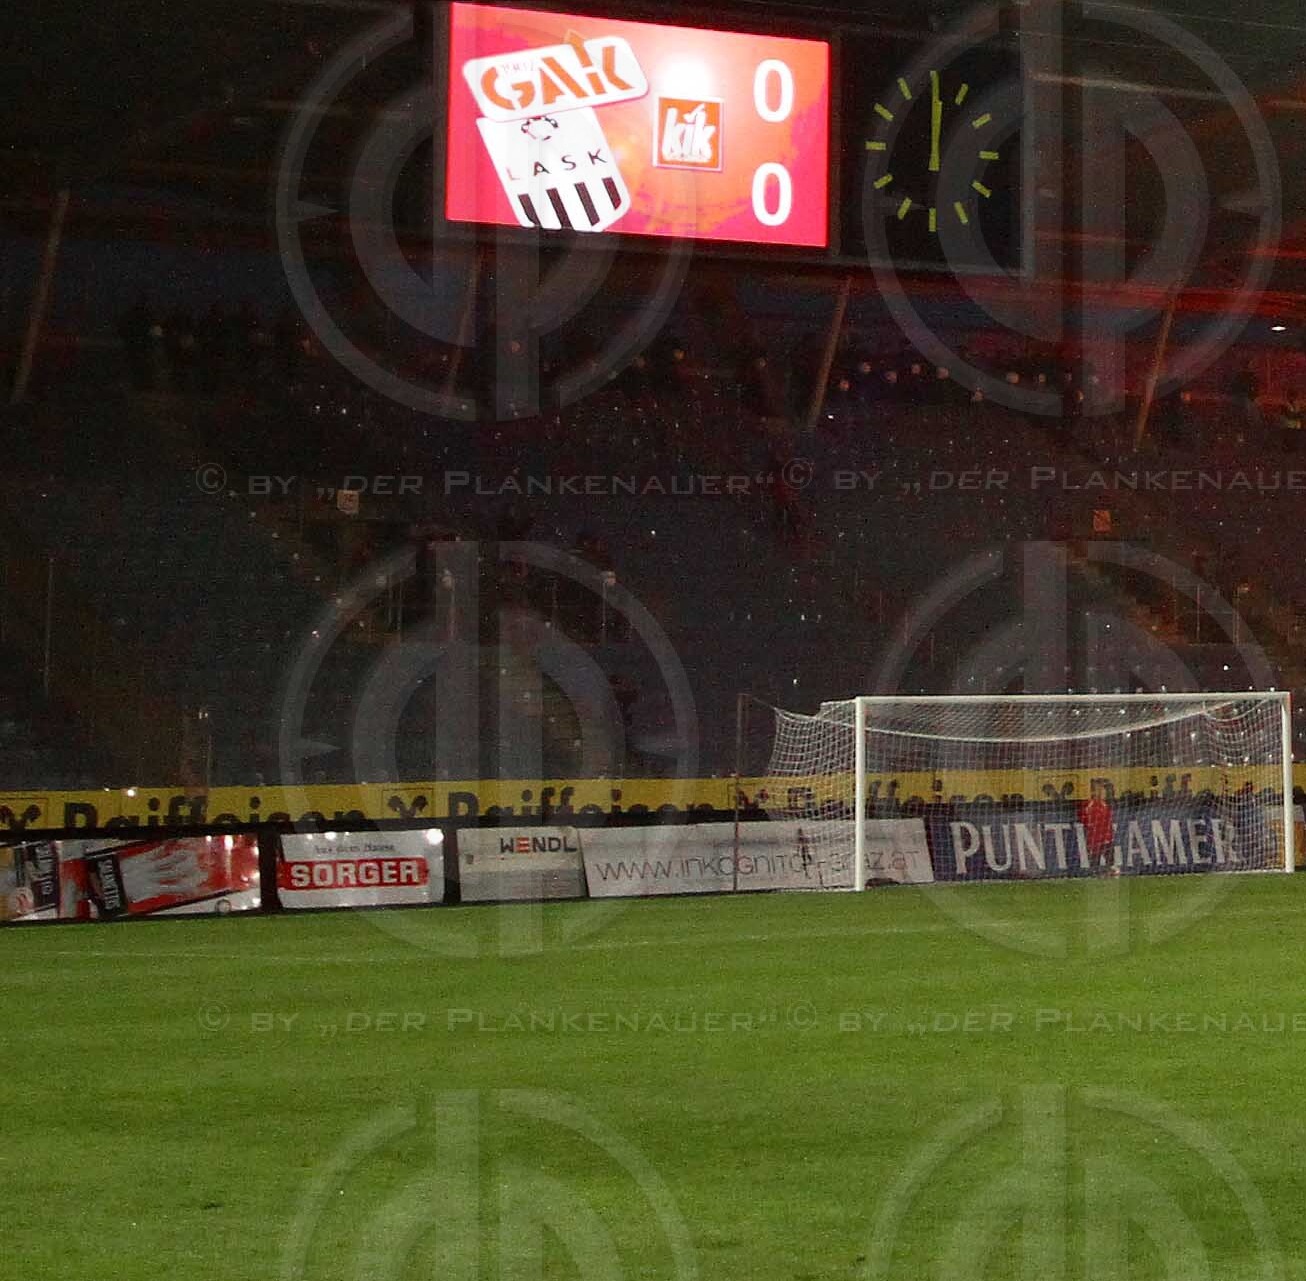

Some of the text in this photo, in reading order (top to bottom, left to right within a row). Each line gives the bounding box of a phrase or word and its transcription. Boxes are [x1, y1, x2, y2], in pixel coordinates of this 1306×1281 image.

[481, 39, 633, 110] GAK
[753, 58, 794, 123] 0
[661, 103, 716, 162] kik
[507, 149, 607, 181] LASK
[752, 162, 793, 227] 0
[291, 860, 419, 887] SORGER
[501, 836, 577, 854] WENDL
[951, 819, 1238, 874] PUNTIAMER
